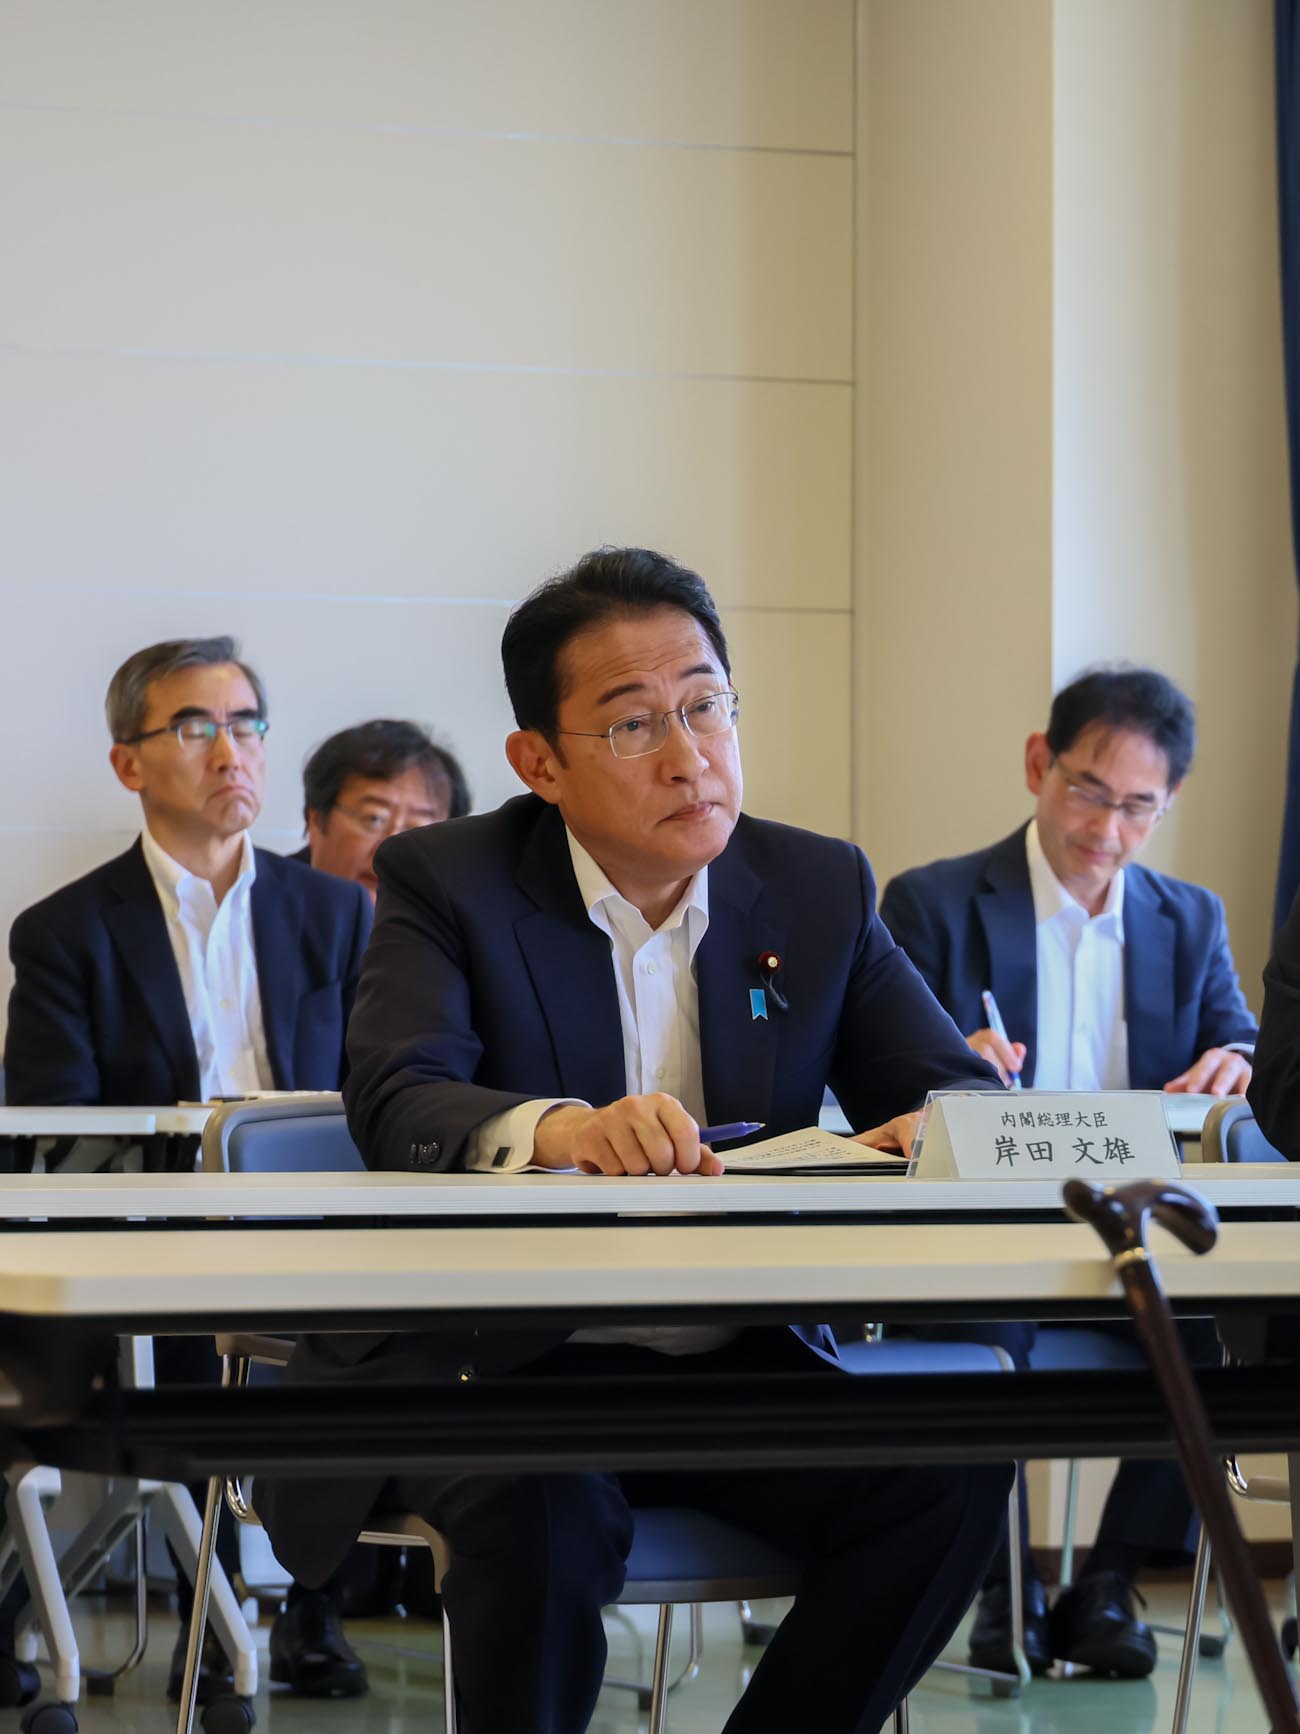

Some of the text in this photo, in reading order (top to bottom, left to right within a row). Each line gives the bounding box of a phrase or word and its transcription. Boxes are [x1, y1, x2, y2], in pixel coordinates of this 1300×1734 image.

[1000, 1111, 1109, 1128] 内閣総理大臣
[994, 1134, 1136, 1167] 岸田 文雄
